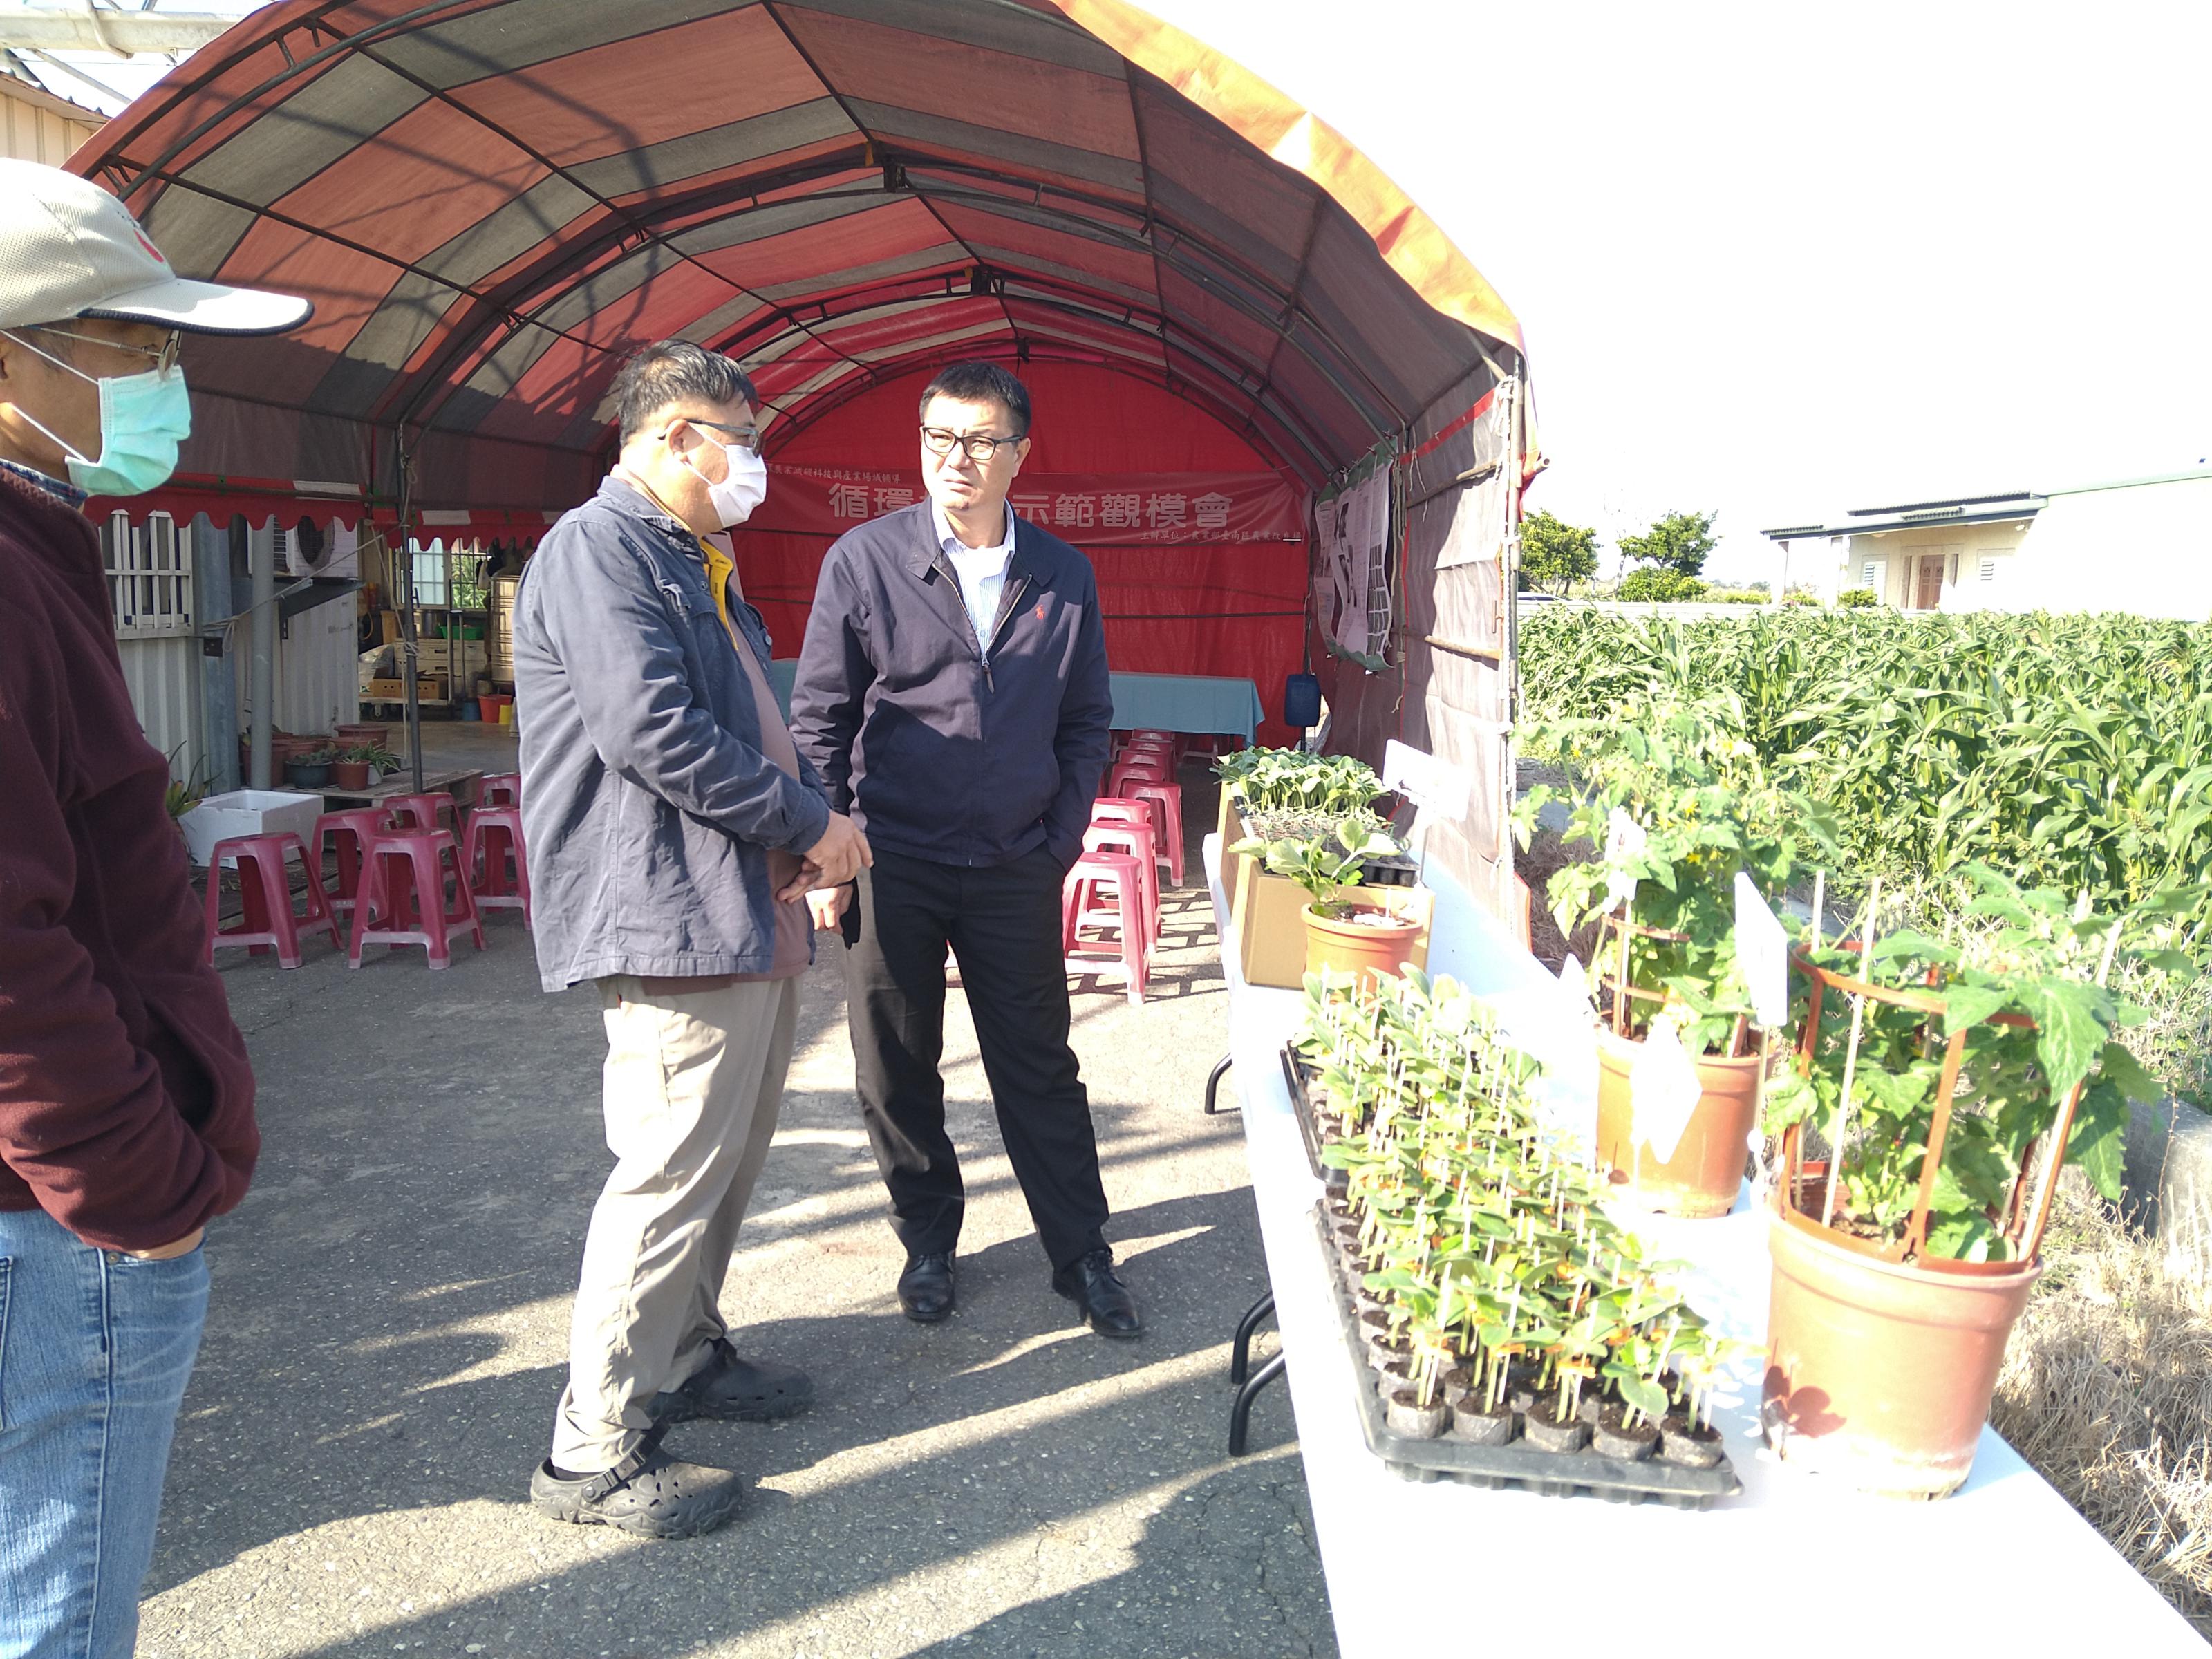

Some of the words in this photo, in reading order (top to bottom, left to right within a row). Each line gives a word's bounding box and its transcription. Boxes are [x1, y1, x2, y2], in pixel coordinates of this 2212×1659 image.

[828, 482, 1234, 528] 循環示範觀模會
